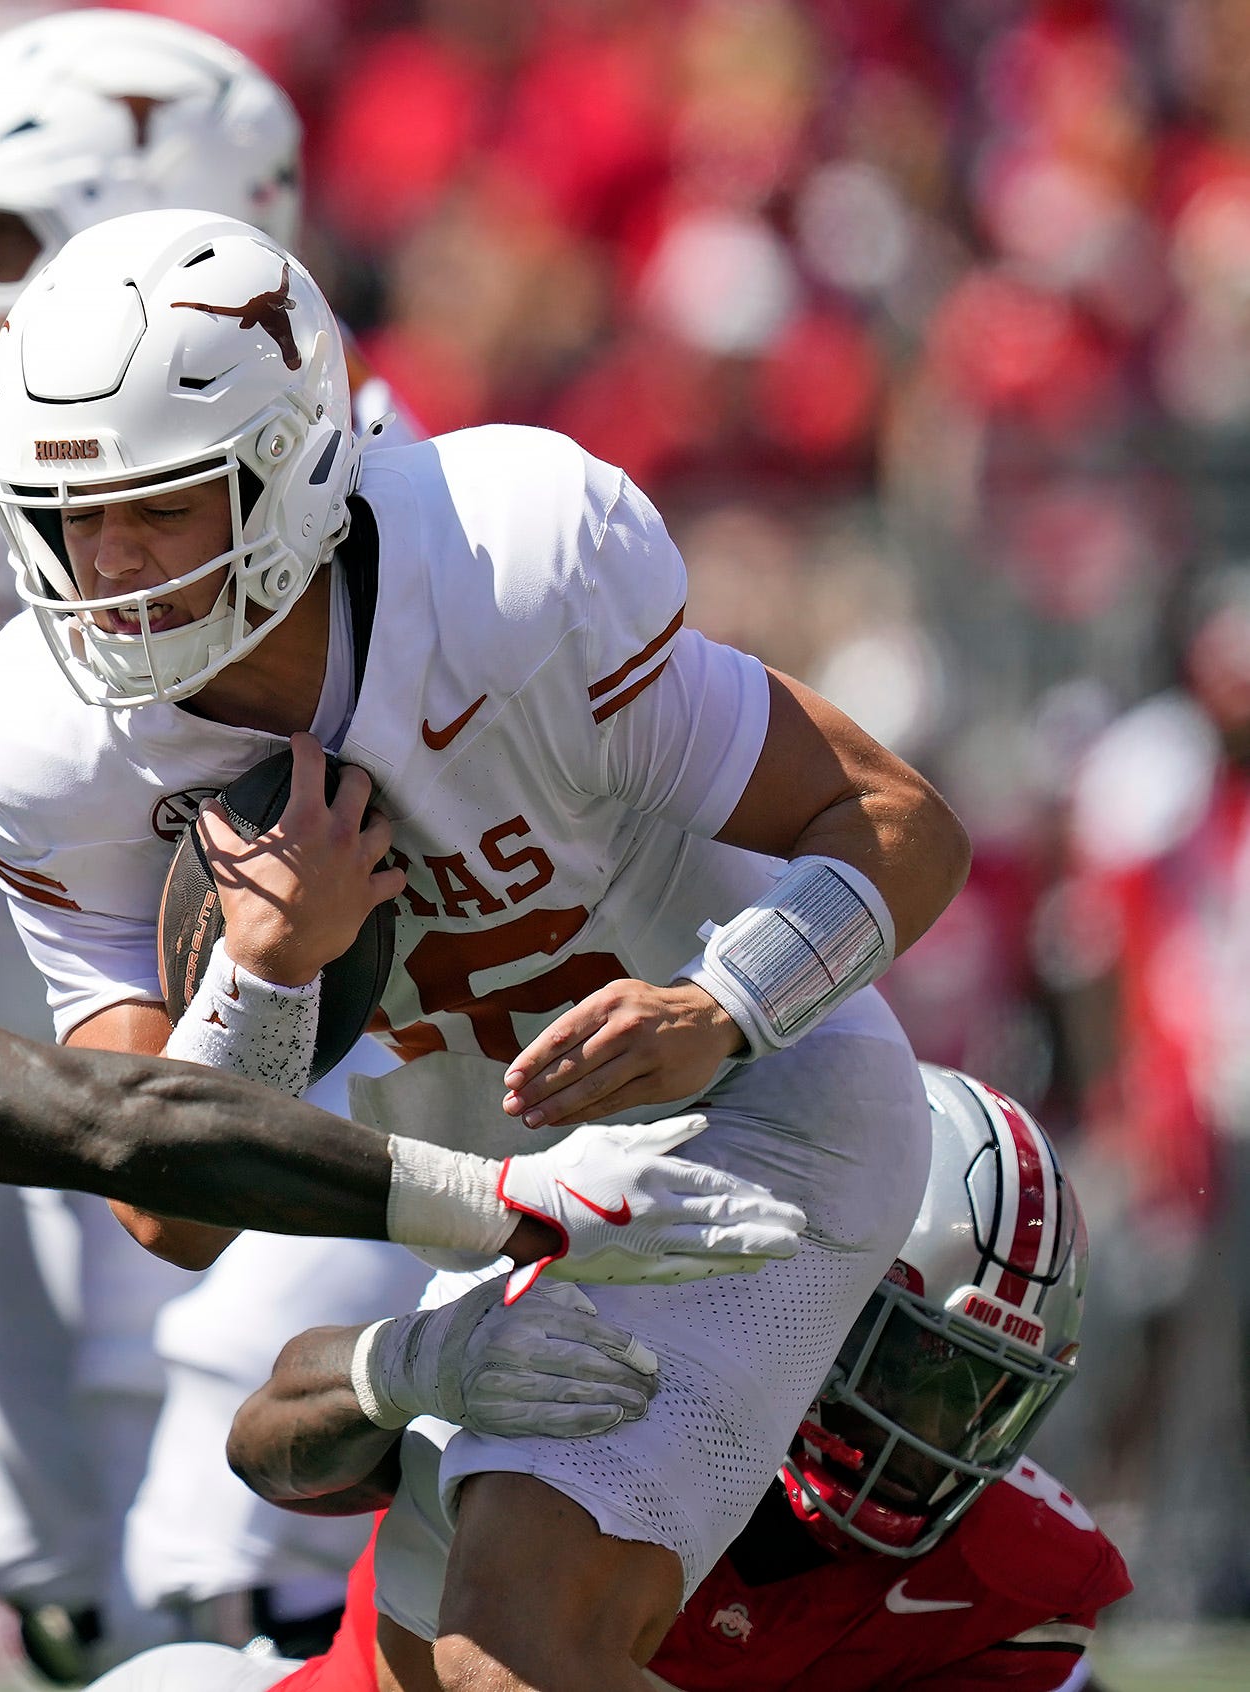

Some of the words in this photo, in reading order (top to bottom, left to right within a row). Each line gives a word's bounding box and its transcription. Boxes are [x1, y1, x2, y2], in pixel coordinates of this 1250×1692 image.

[34, 439, 99, 460] HORNS
[390, 814, 555, 918] XAS
[191, 889, 218, 952] ELITE
[184, 949, 199, 1009] APOR
[964, 1295, 1003, 1328] OHIO
[1002, 1313, 1044, 1347] STATE
